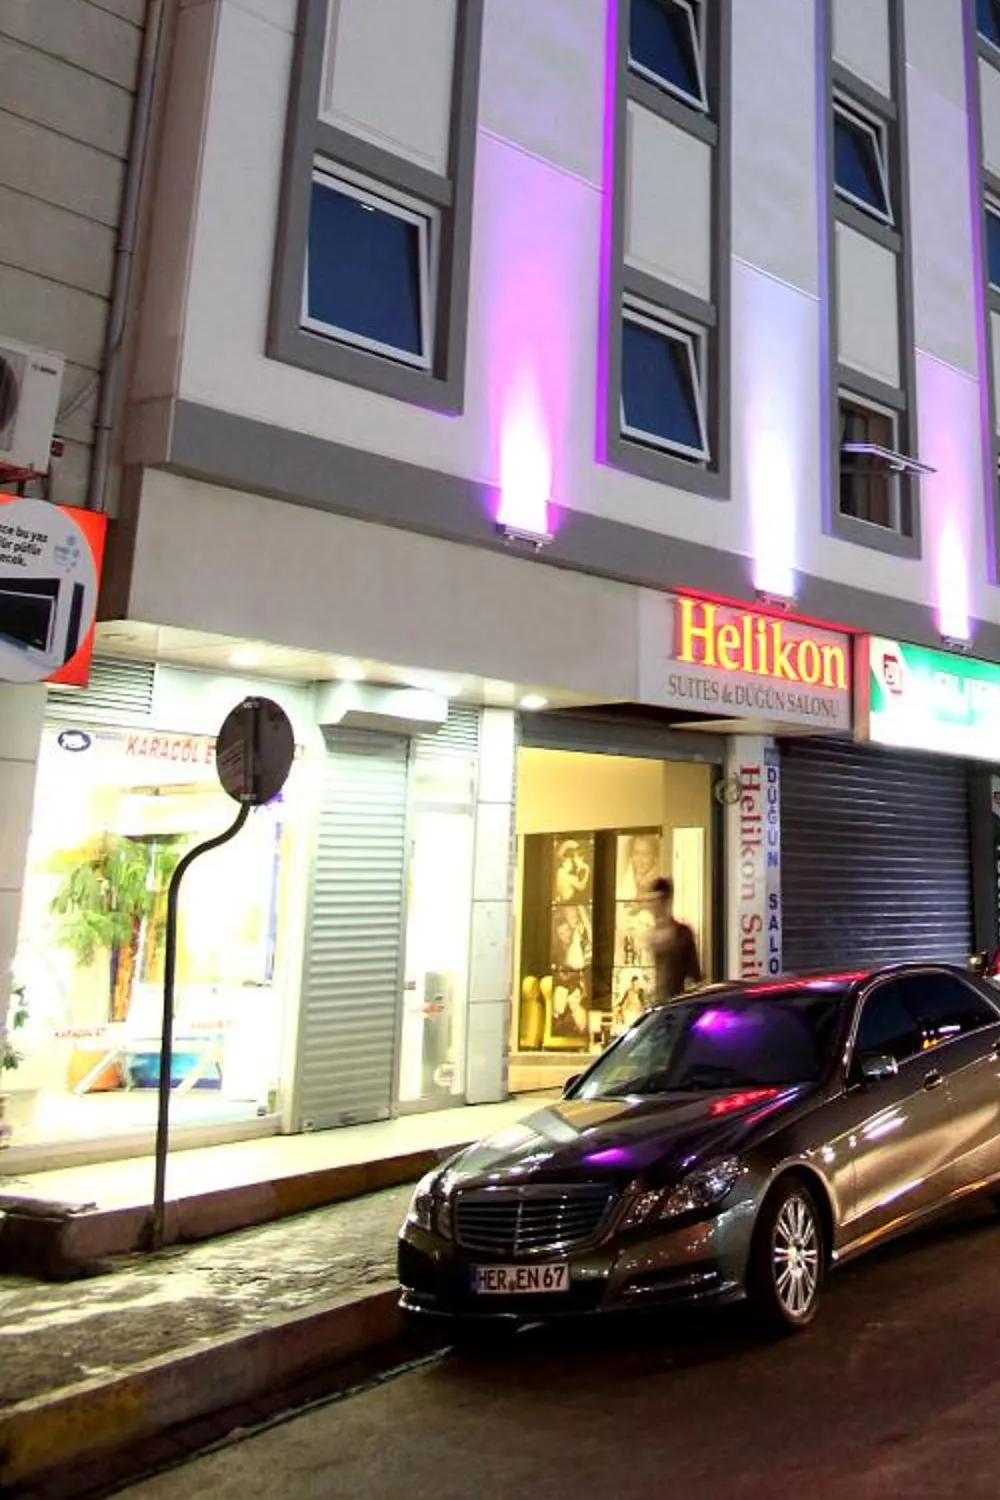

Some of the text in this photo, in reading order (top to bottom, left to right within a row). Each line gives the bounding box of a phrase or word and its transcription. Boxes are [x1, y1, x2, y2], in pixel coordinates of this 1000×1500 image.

[677, 595, 846, 690] Helikon
[740, 764, 763, 979] Helikon Suit
[769, 892, 779, 975] SALO
